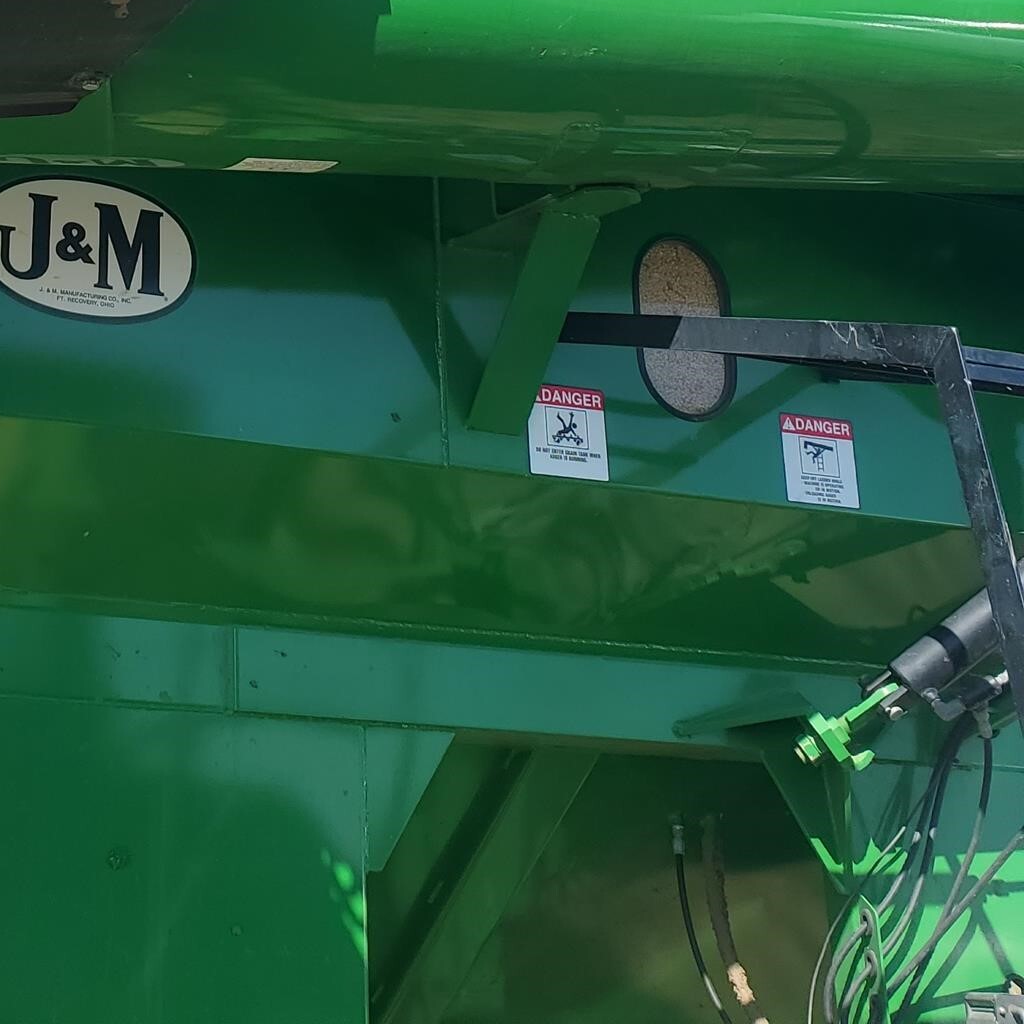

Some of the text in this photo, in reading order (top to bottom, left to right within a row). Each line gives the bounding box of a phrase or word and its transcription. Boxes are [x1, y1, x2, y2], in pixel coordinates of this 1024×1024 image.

[60, 289, 108, 301] MANUFACTURING
[100, 301, 115, 309] OHIO
[542, 388, 602, 408] DANGER
[795, 417, 850, 436] DANGER
